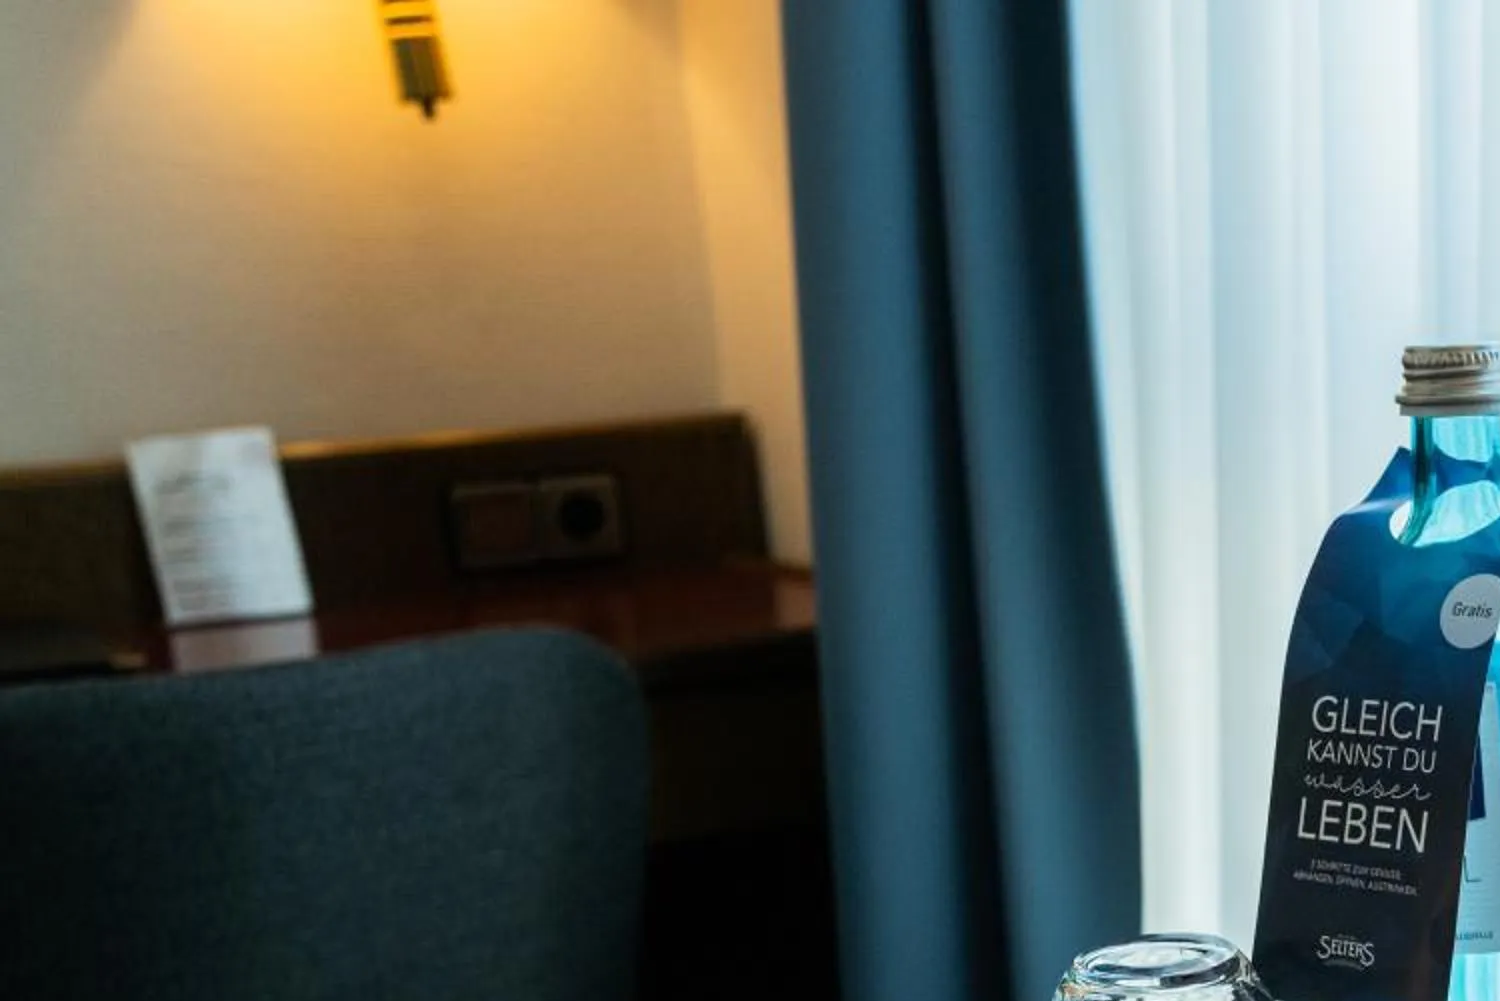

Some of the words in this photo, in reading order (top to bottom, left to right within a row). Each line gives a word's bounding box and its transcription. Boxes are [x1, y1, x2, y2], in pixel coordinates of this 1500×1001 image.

[1452, 601, 1493, 619] Gratis
[1312, 695, 1443, 742] GLEICH
[1307, 738, 1398, 769] KANNST
[1402, 747, 1437, 773] DU
[1297, 796, 1429, 853] LEBEN
